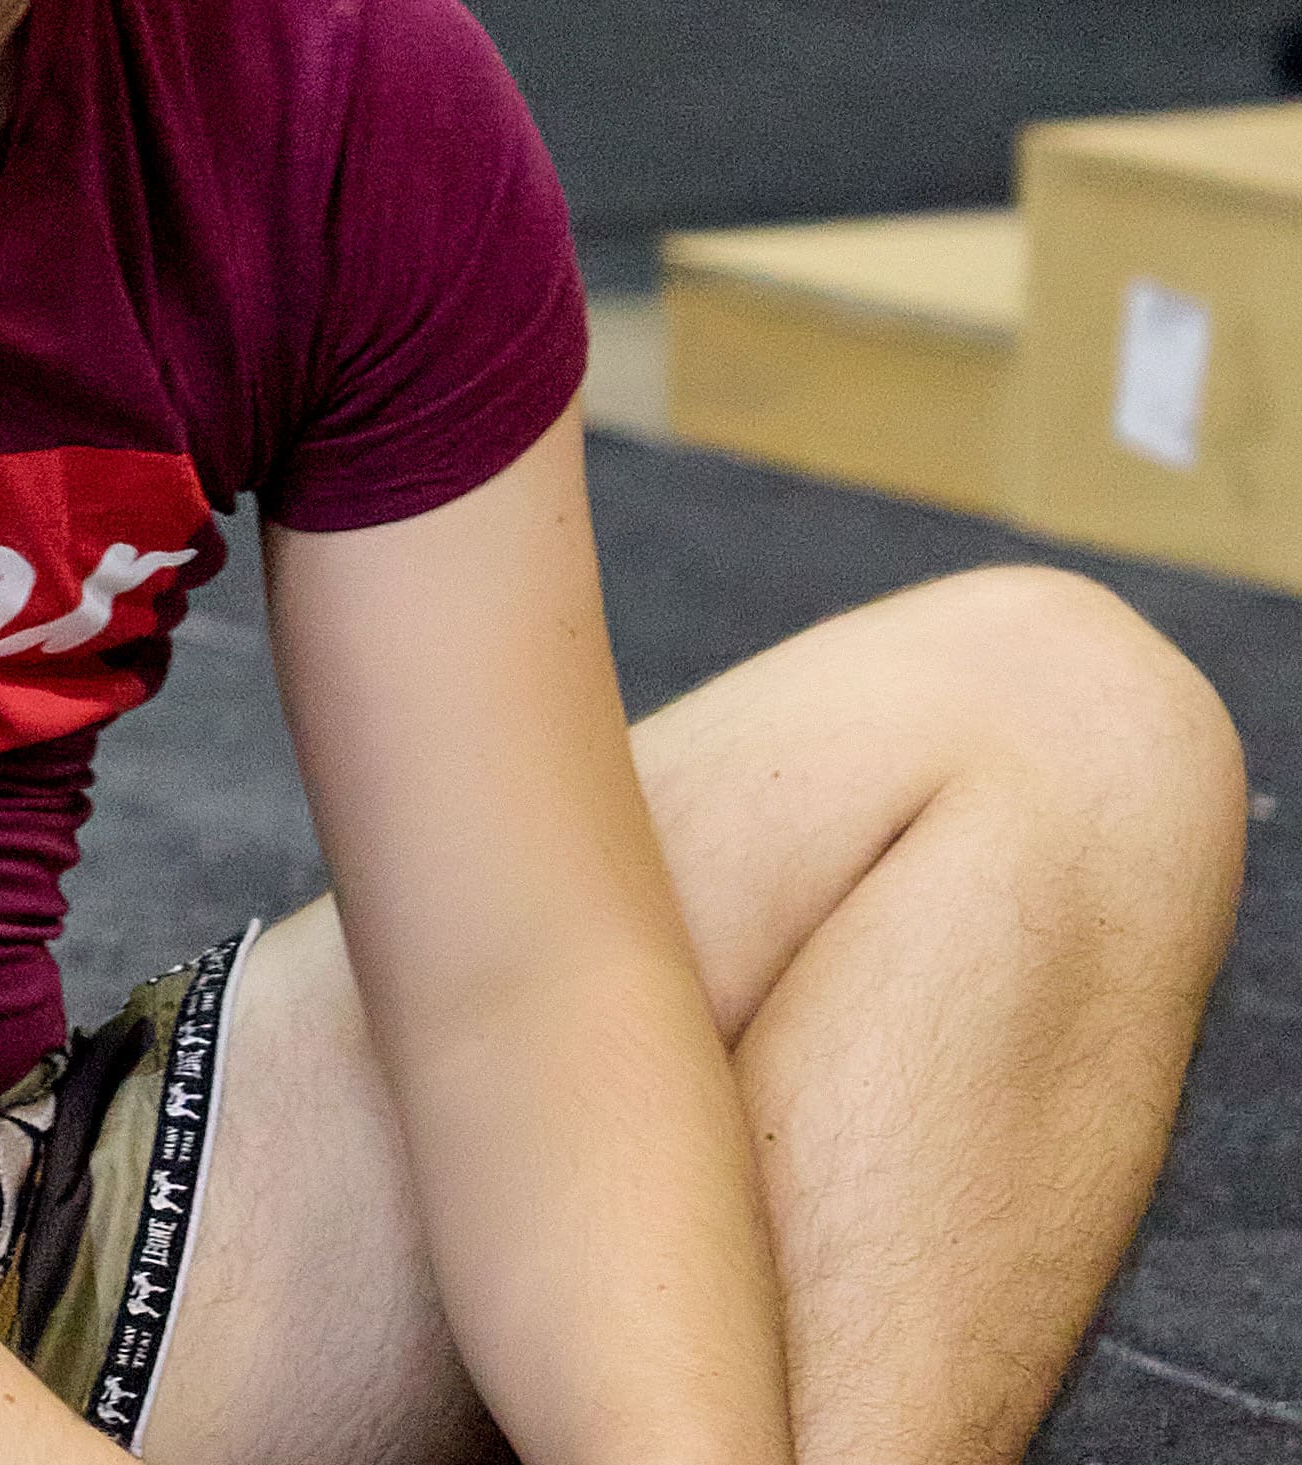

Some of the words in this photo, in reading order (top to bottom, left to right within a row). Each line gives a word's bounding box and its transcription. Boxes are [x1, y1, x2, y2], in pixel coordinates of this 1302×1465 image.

[140, 1217, 178, 1267] LEONE
[115, 1325, 137, 1366] MUAY
[132, 1331, 152, 1367] THAI
